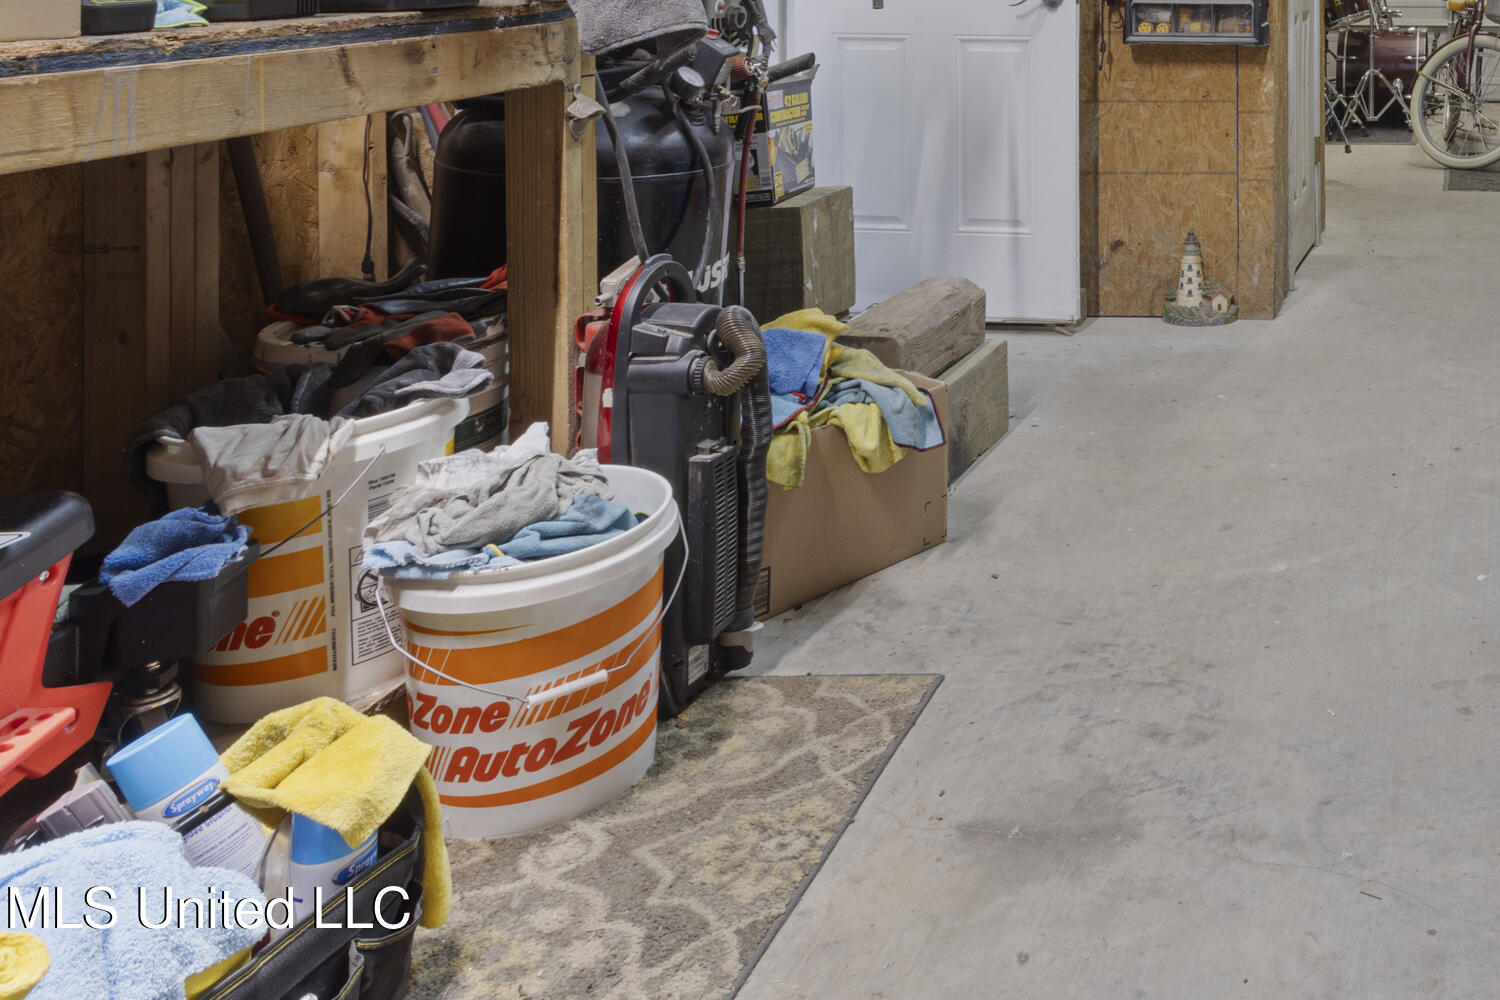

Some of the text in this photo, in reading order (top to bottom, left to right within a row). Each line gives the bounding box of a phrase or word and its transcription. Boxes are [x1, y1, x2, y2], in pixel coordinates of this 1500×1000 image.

[444, 679, 651, 783] AutoZone
[170, 780, 215, 814] Sprayway
[347, 854, 376, 878] Spray
